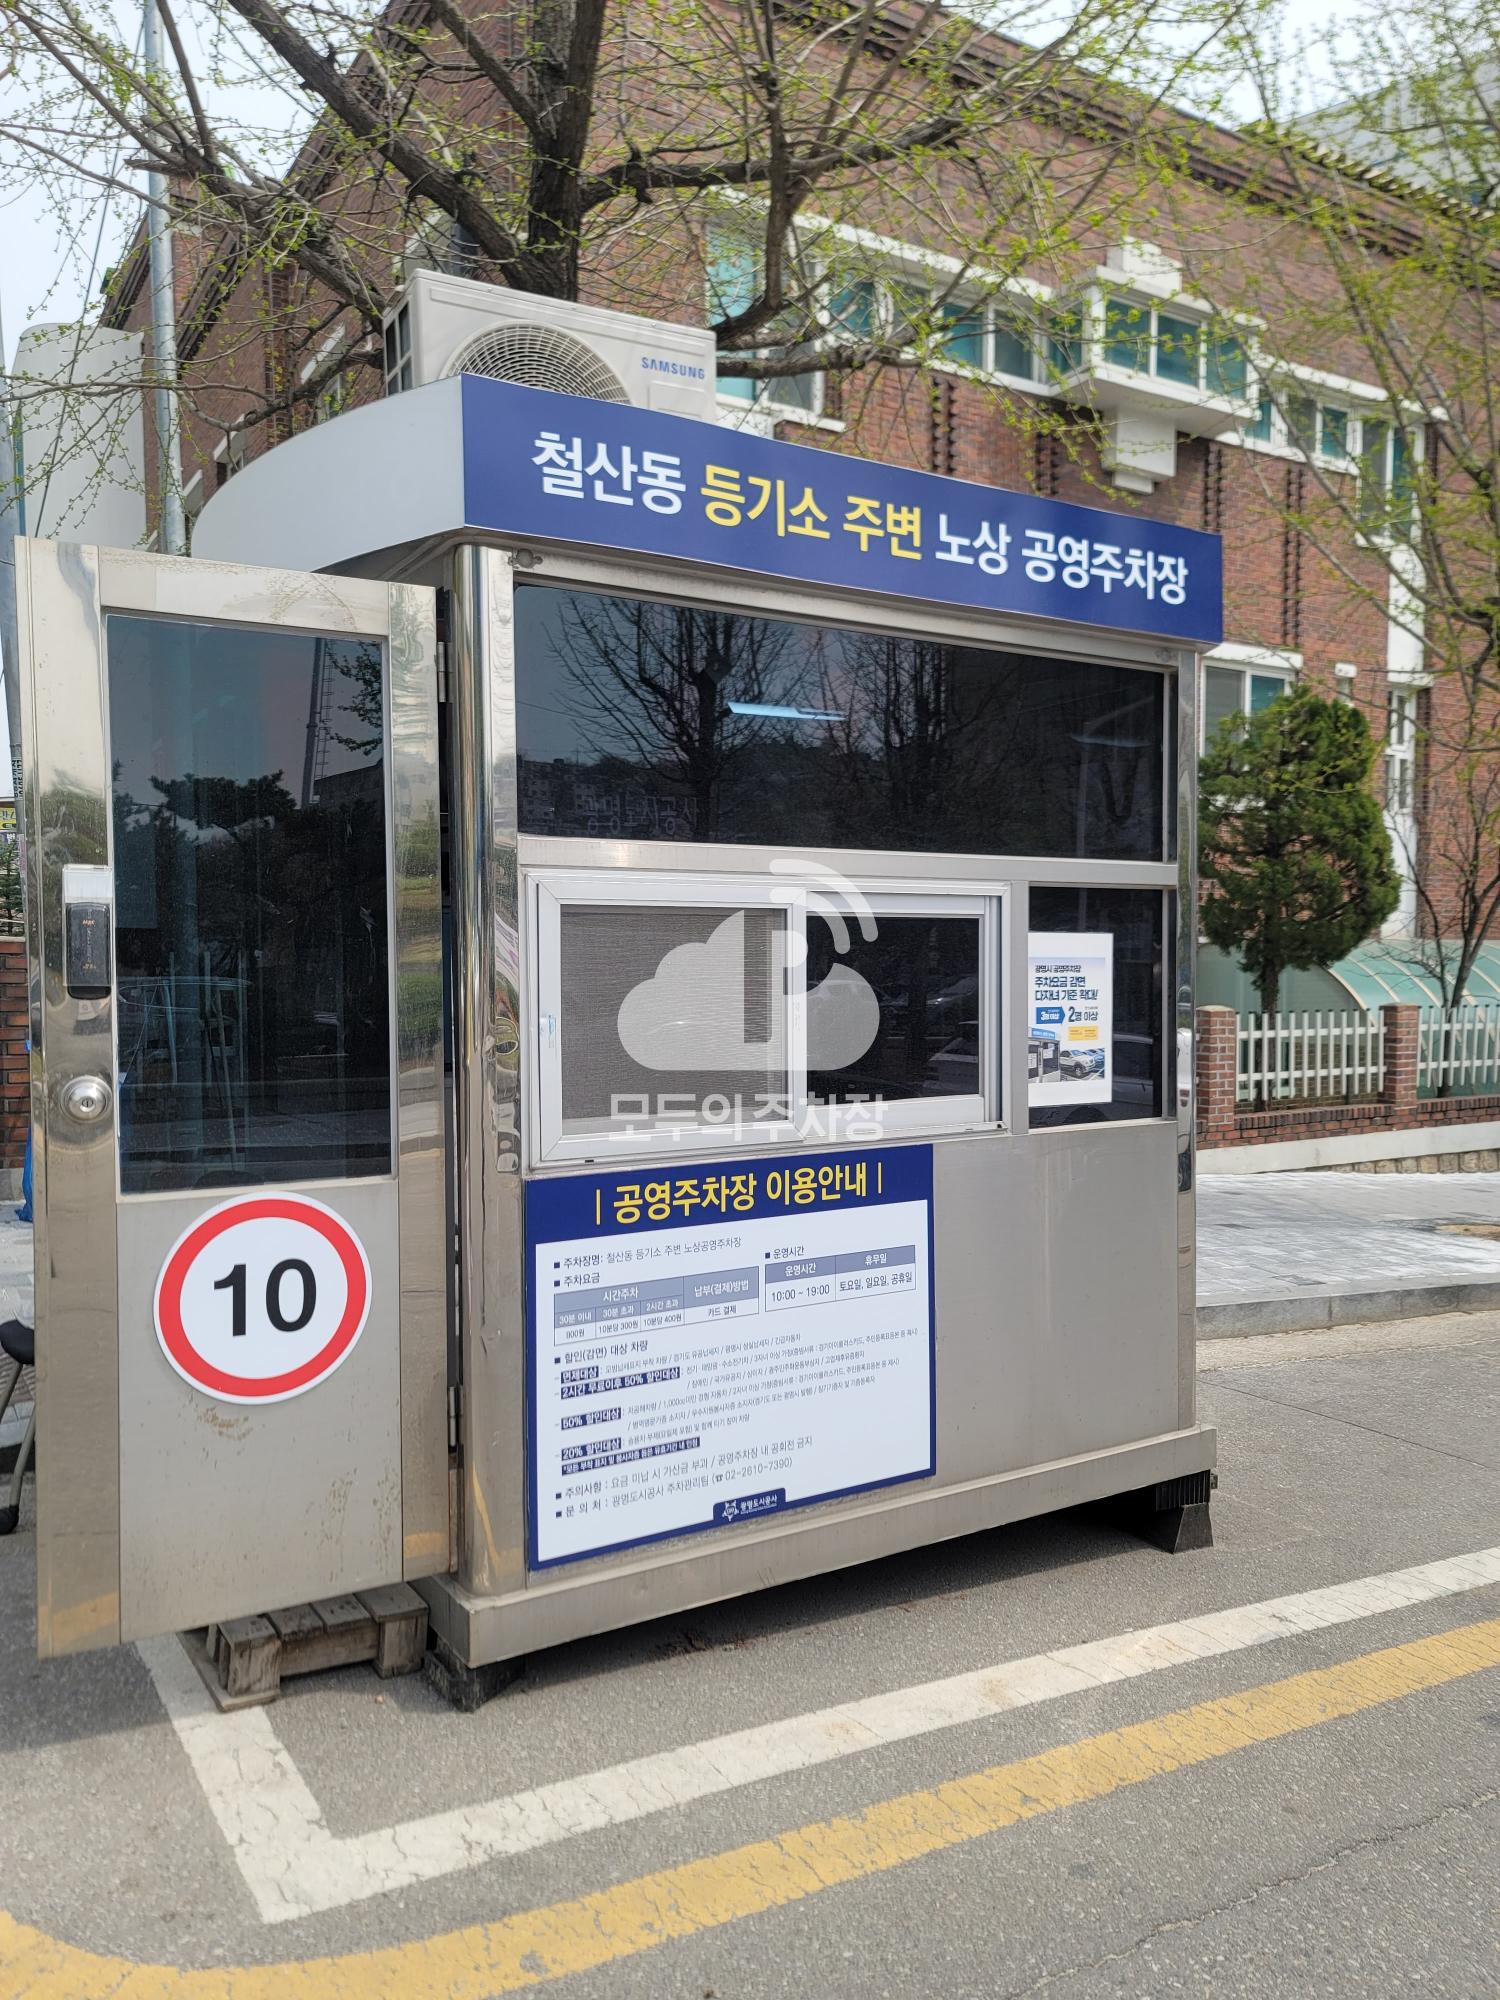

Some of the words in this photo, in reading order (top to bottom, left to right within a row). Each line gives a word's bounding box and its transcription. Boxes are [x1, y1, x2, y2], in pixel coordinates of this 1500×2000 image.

[641, 357, 704, 379] SAMSUNG
[532, 431, 686, 515] 철산동
[701, 464, 829, 540] 등기소
[843, 494, 922, 561] 주변
[936, 513, 1011, 576] 노상
[1021, 529, 1188, 605] 공영주차장
[1035, 976, 1067, 988] 주차요금
[1070, 976, 1085, 987] 감면
[1035, 990, 1060, 1001] 다자녀
[1061, 990, 1077, 1001] 기준
[1068, 1006, 1082, 1022] 2명
[1084, 1011, 1098, 1021] 이상
[613, 1171, 757, 1224] 공영주차장
[765, 1161, 869, 1208] 이용안내
[664, 1243, 681, 1256] 주변
[684, 1236, 741, 1254] 노상공영주차장
[773, 1245, 804, 1259] 운영시간
[784, 1262, 816, 1277] 운영시간
[864, 1252, 887, 1266] 휴무일
[563, 1272, 600, 1287] 주차요금
[890, 1271, 912, 1285] 공휴일
[213, 1258, 317, 1336] 10
[602, 1286, 639, 1303] 시간주차
[771, 1288, 796, 1302] 10:00
[806, 1283, 829, 1297] 19:00
[610, 1342, 627, 1357] 대상
[565, 1480, 601, 1498] 주의사항
[611, 1474, 628, 1488] 요금
[652, 1467, 661, 1480] 시
